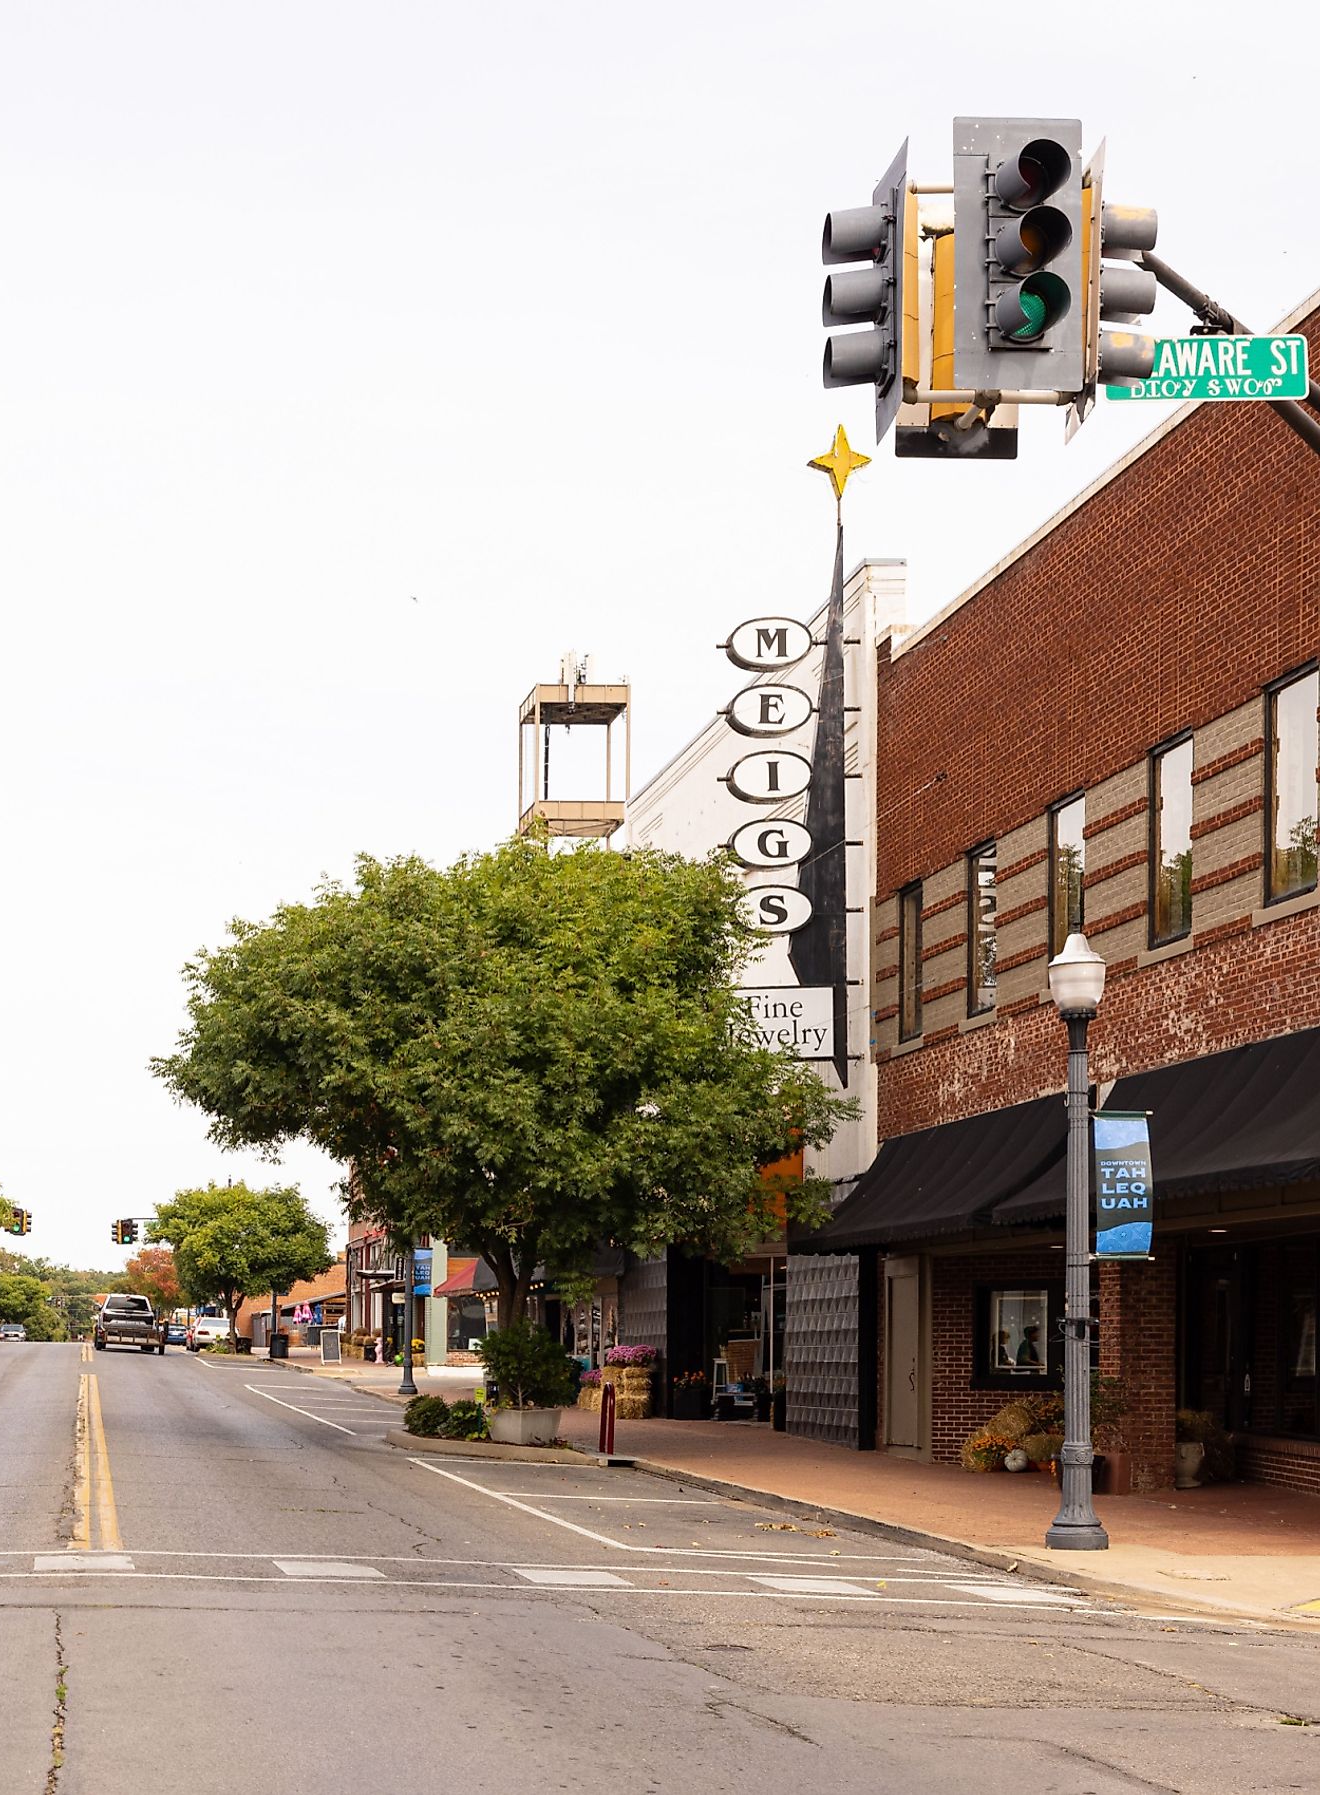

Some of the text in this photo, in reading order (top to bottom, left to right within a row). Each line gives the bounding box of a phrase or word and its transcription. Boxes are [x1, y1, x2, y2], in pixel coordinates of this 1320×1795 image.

[1151, 339, 1302, 377] AWARE ST
[756, 628, 789, 926] MEIGS
[745, 994, 803, 1019] Fine
[1101, 1167, 1146, 1179] TAH
[1102, 1182, 1146, 1195] LEQ
[1101, 1197, 1148, 1209] UAH
